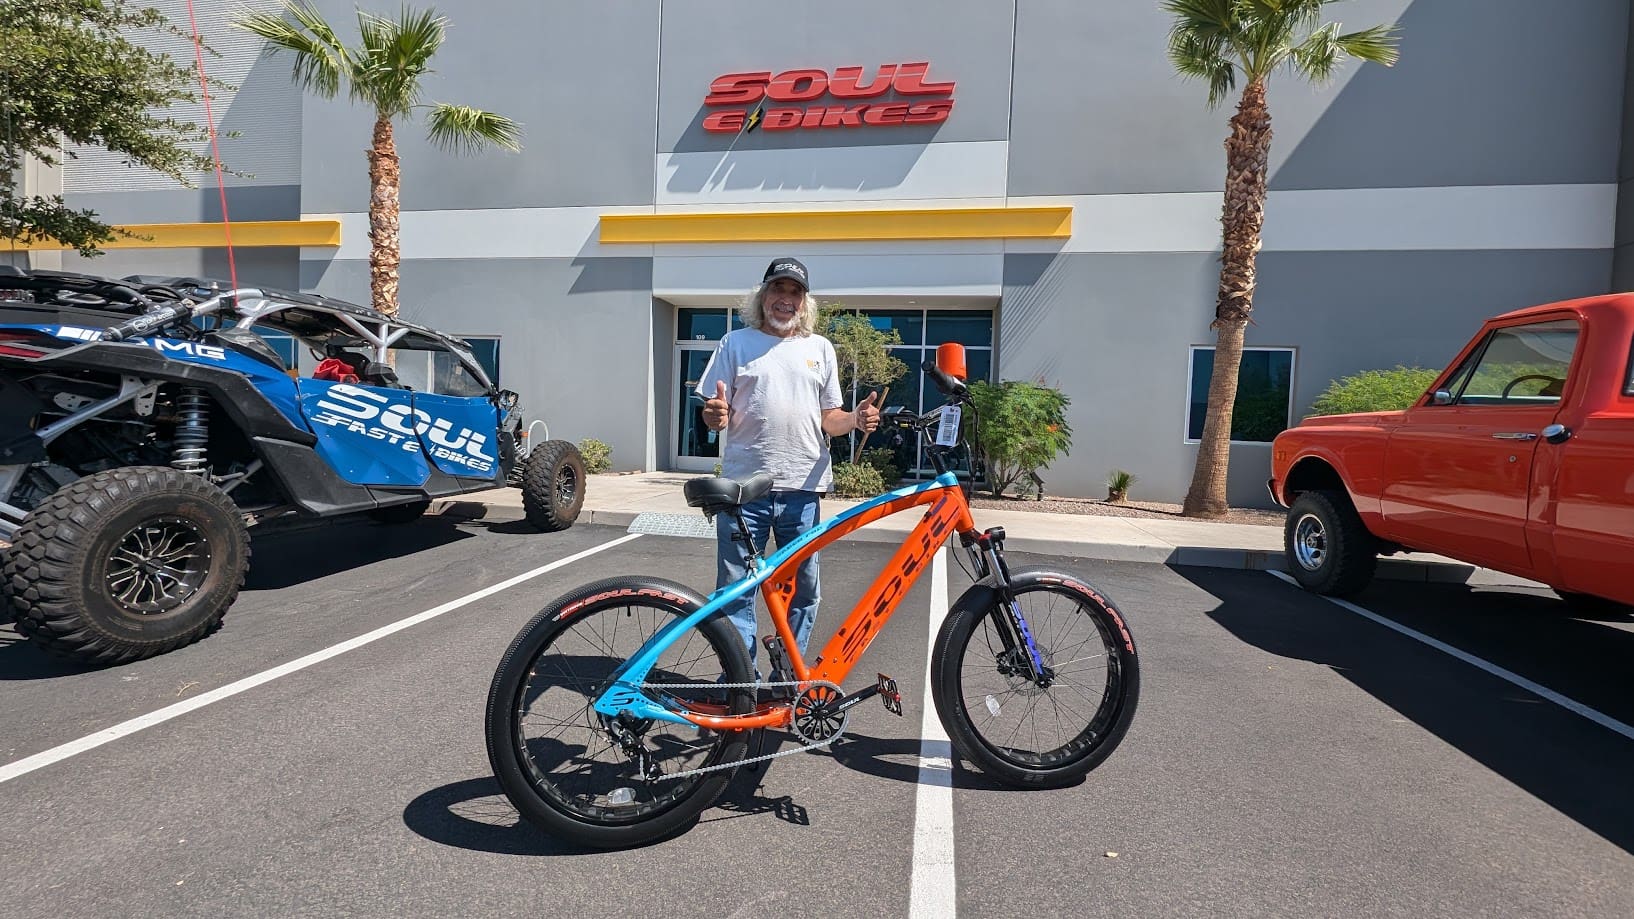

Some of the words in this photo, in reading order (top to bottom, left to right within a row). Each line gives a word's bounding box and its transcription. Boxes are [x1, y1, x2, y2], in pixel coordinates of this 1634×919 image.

[704, 62, 956, 105] SOUL
[761, 98, 955, 130] BIKES
[138, 338, 226, 361] MG
[311, 411, 405, 446] FAST
[434, 448, 492, 472] BIKES
[317, 384, 494, 463] SOUL
[583, 588, 637, 606] SOUL
[637, 588, 689, 605] FAST
[841, 503, 961, 664] SOUL
[1062, 579, 1106, 609] SOUL
[1106, 607, 1134, 655] FAST
